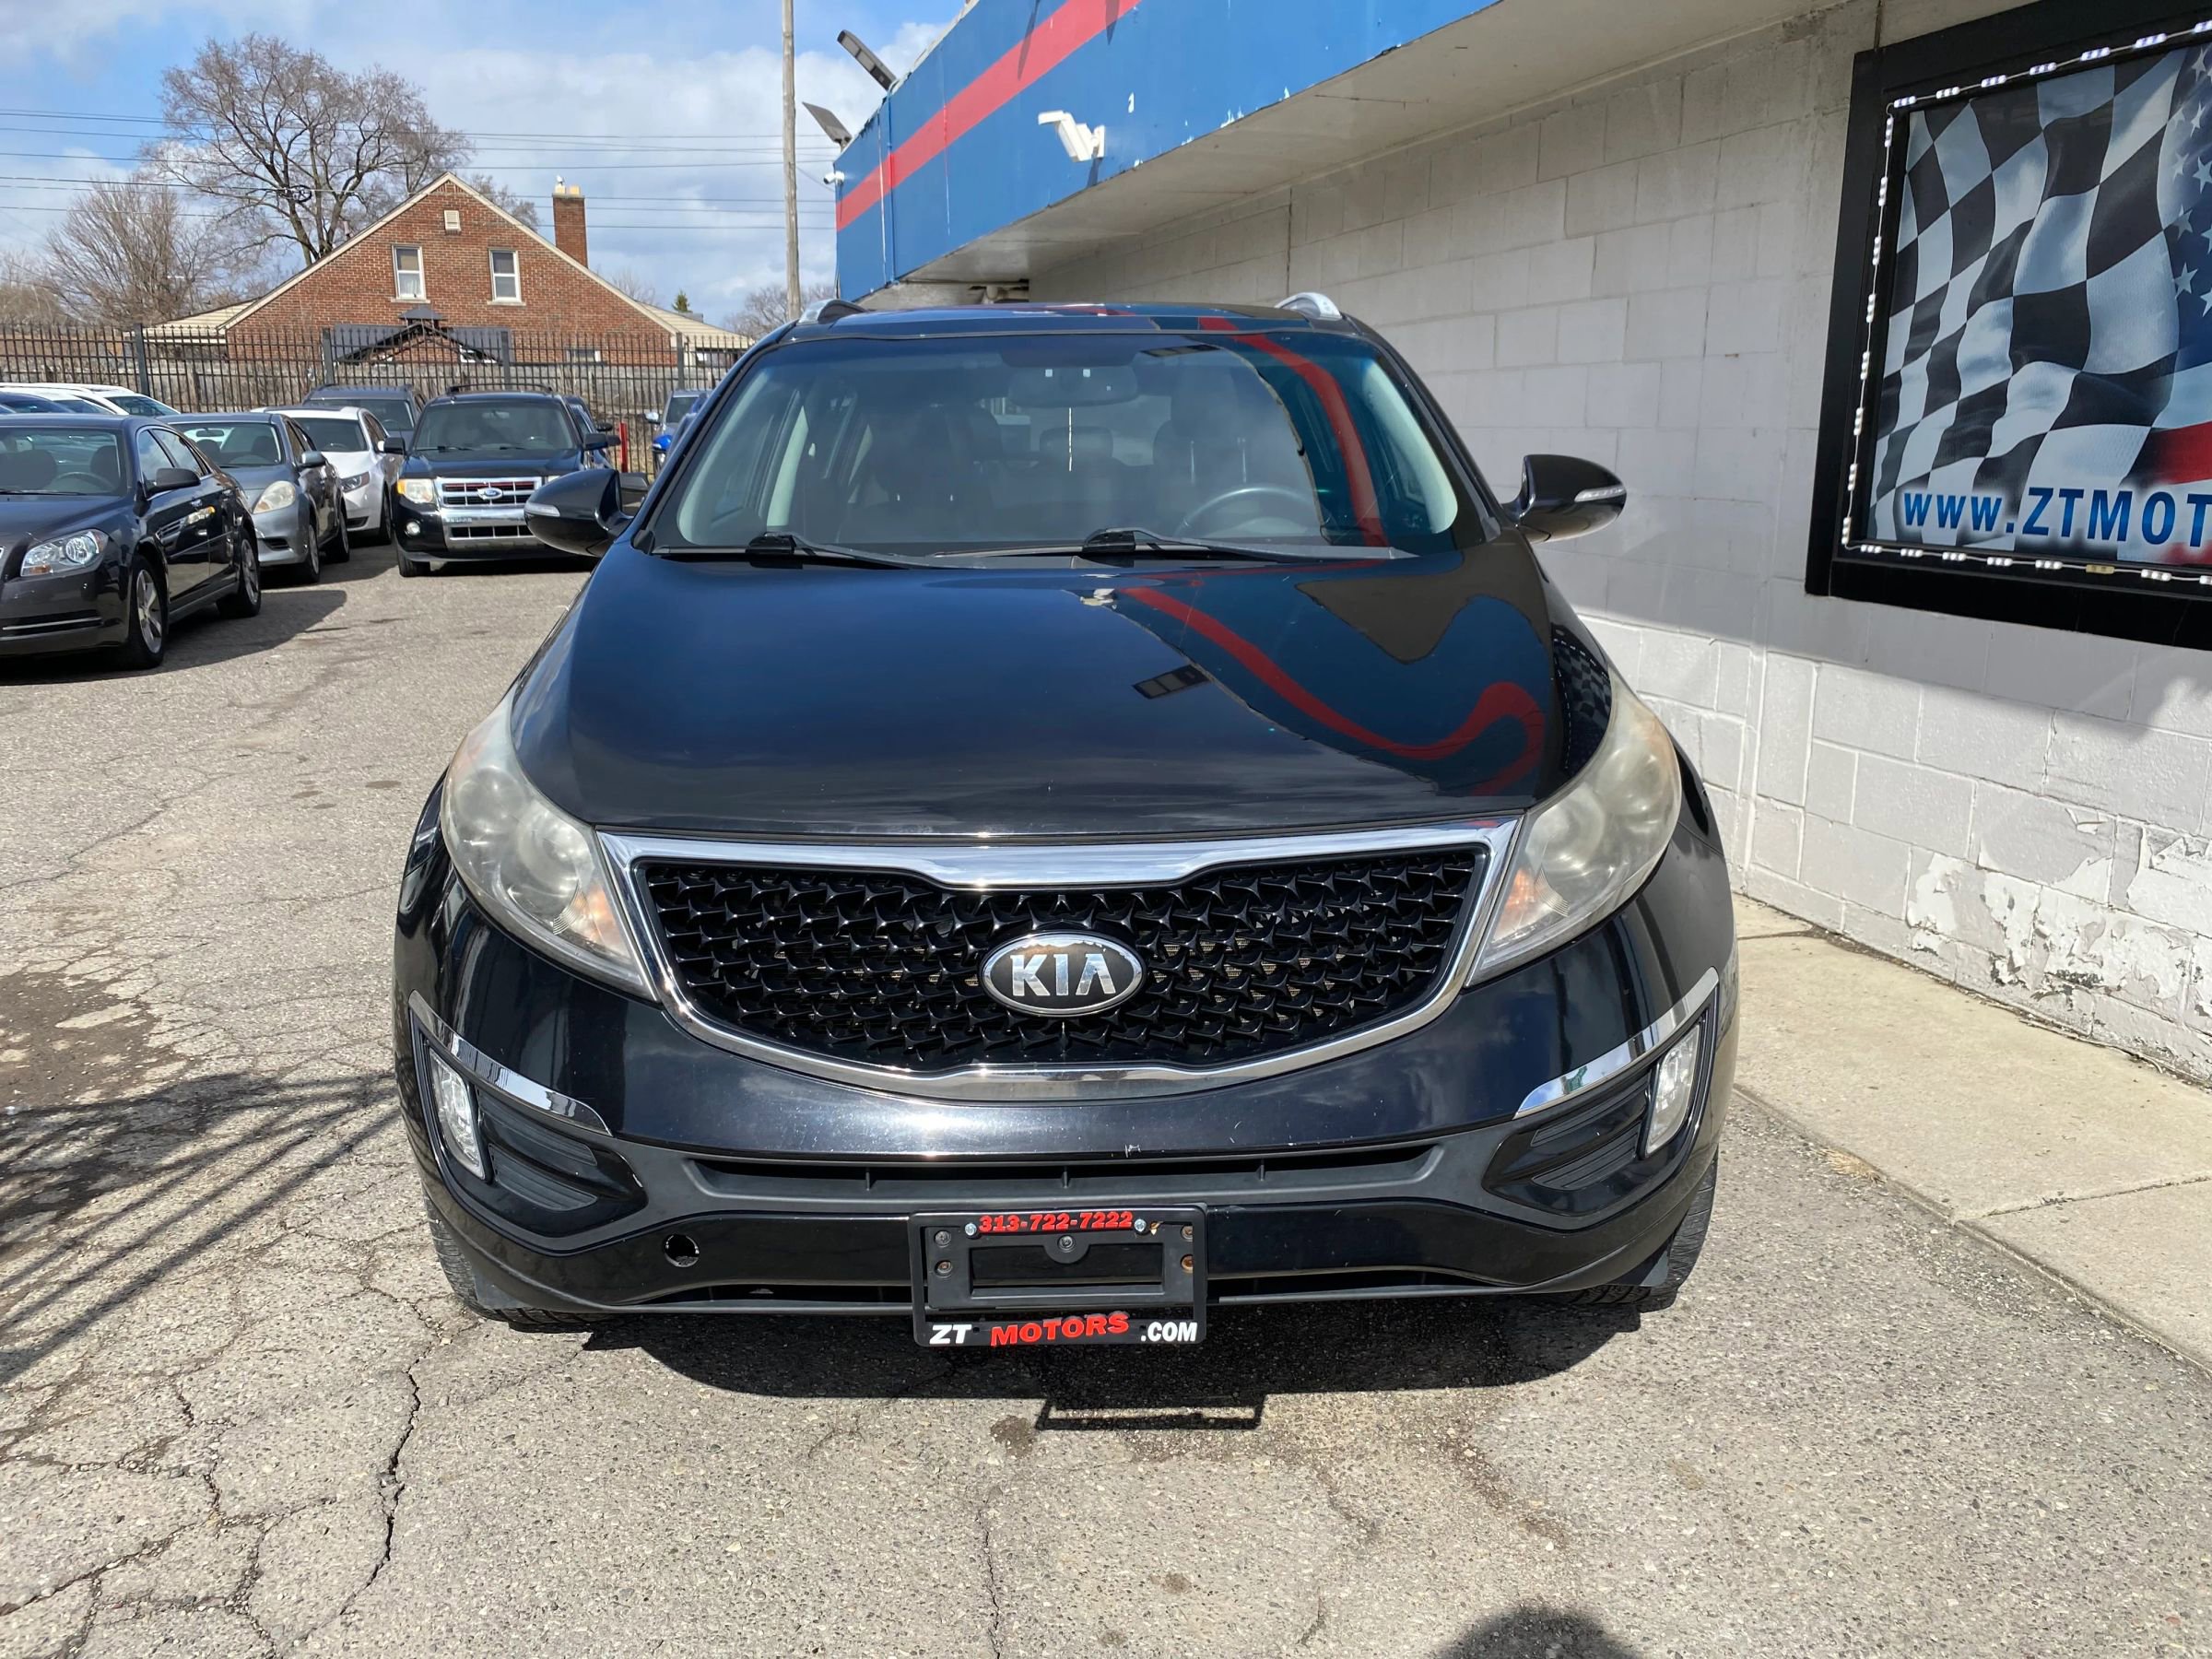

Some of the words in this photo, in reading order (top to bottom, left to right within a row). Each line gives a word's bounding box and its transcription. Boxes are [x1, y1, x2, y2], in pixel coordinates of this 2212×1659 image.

[1010, 953, 1116, 996] KIA
[979, 1211, 1134, 1232] 313-722-7222
[929, 1324, 971, 1345] ZT
[990, 1312, 1130, 1347] MOTORS
[1140, 1321, 1198, 1342] .COM
